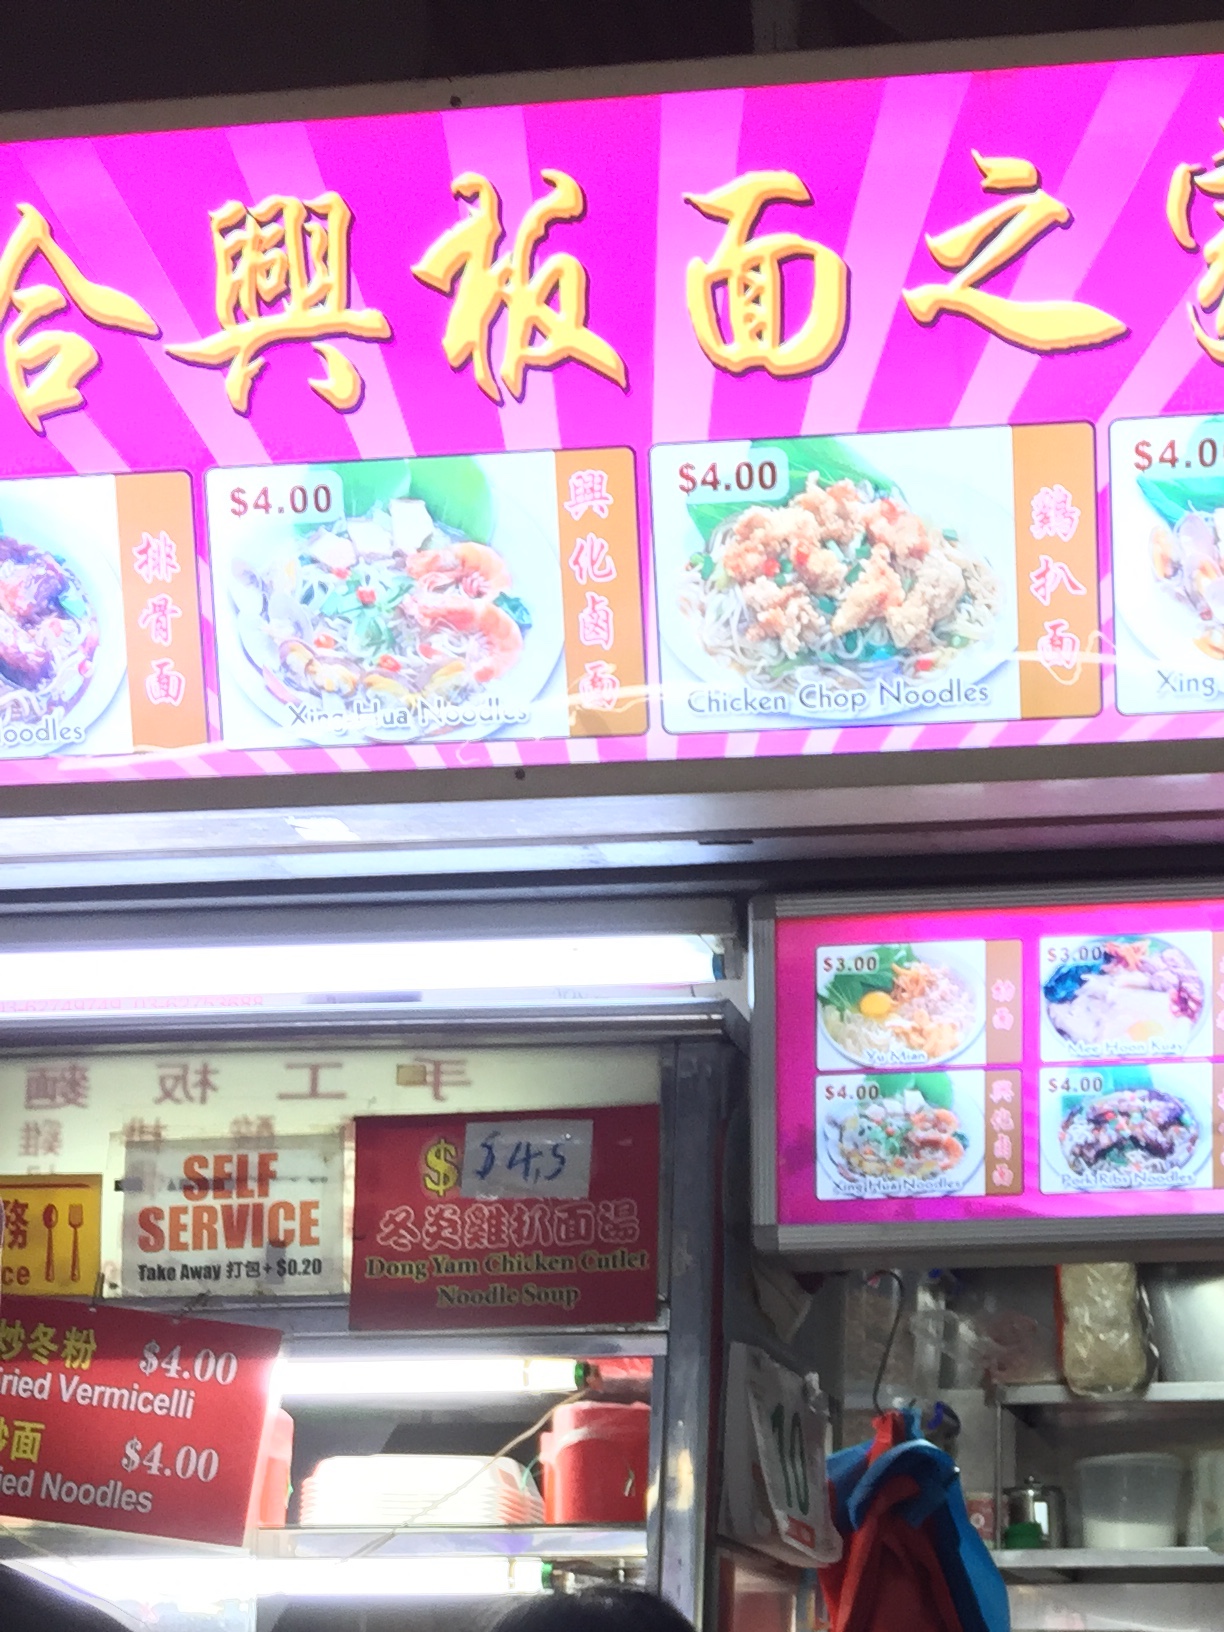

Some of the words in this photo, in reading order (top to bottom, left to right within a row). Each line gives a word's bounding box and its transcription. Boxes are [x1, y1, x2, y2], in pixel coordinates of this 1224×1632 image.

[677, 460, 779, 495] $4.00
[229, 483, 333, 518] $4.00
[132, 530, 186, 707] 排骨面
[687, 686, 786, 714] Chicken
[799, 683, 867, 713] Chop
[879, 677, 989, 707] Noodles
[1156, 668, 1215, 697] Xing
[822, 956, 877, 972] $3.00
[1047, 946, 1101, 962] $3.00
[890, 1049, 925, 1062] Mian
[825, 1085, 879, 1100] $4.00
[1048, 1077, 1103, 1092] $4.00
[182, 1152, 279, 1202] SELF
[423, 1138, 458, 1197] $
[868, 1179, 898, 1191] Hua
[902, 1178, 960, 1191] Noodles
[1100, 1172, 1129, 1184] Ribs
[1134, 1169, 1194, 1184] Noodles
[137, 1199, 321, 1253] SERVICE
[138, 1263, 177, 1282] Take
[180, 1261, 221, 1282] Away
[276, 1258, 322, 1277] $0.20
[365, 1257, 427, 1282] Dong
[432, 1253, 479, 1276] Yam
[485, 1251, 573, 1274] Chicken
[580, 1248, 648, 1271] Cutlet
[436, 1285, 518, 1308] Noodle
[521, 1283, 579, 1310] Soup
[138, 1339, 238, 1386] $4.00
[0, 1366, 52, 1401] ried
[58, 1373, 195, 1420] Vermicelli
[121, 1436, 220, 1483] $4.00
[40, 1471, 154, 1514] Noodles
